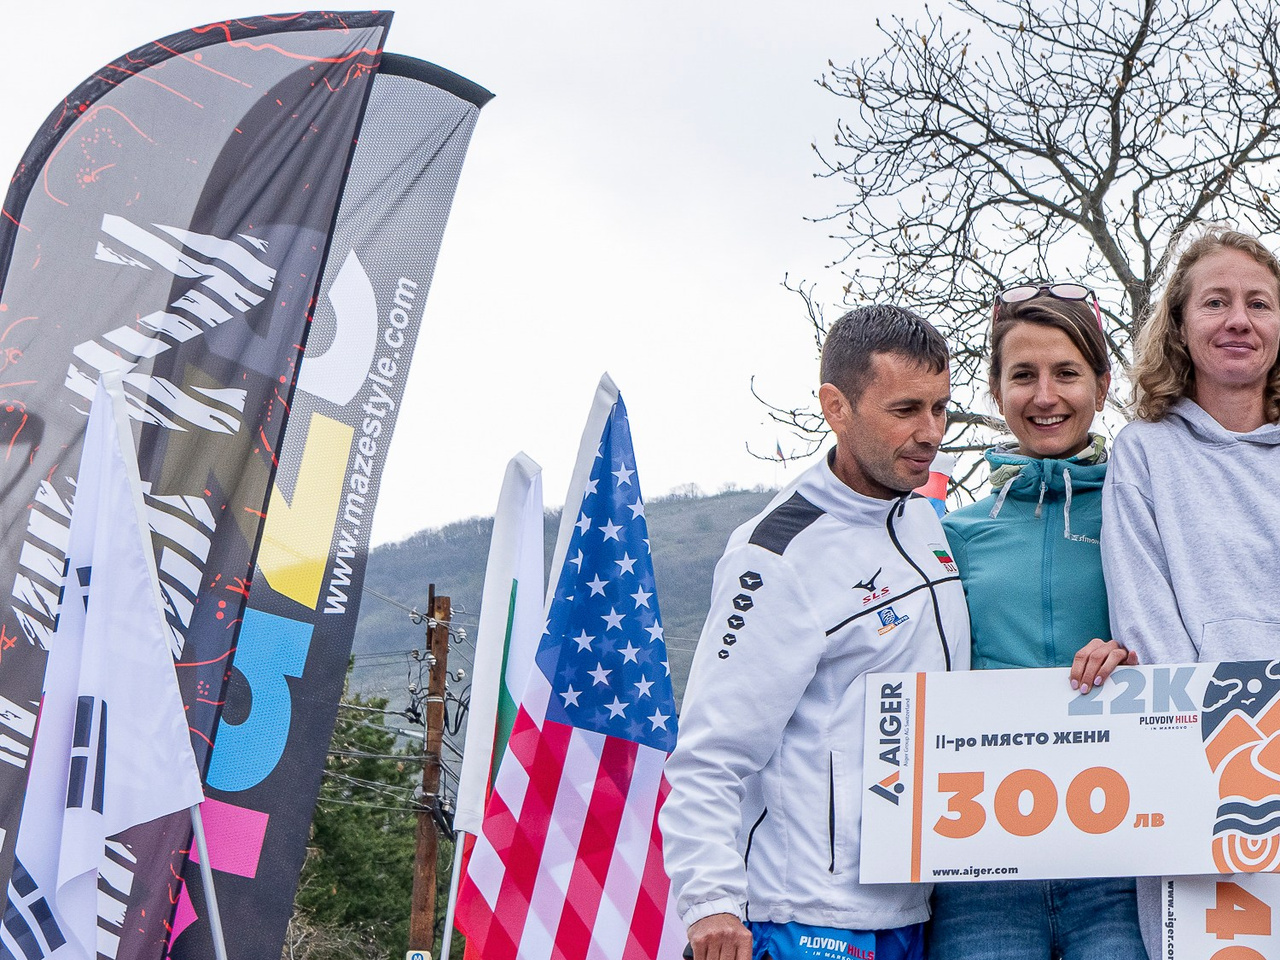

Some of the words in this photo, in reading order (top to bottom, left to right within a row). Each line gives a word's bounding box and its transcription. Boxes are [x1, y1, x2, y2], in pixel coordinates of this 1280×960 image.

[323, 277, 418, 614] www.mazestyle.com
[862, 586, 890, 604] SLS
[879, 681, 903, 767] AIGER
[1139, 715, 1175, 726] PLOVDIV
[1175, 714, 1198, 724] HILLS
[981, 731, 1050, 748] МЯСТО
[1053, 729, 1110, 745] ЖЕНИ
[933, 766, 1130, 839] 300
[932, 864, 1019, 879] www.aiger.com
[799, 935, 847, 952] PLOVDIV
